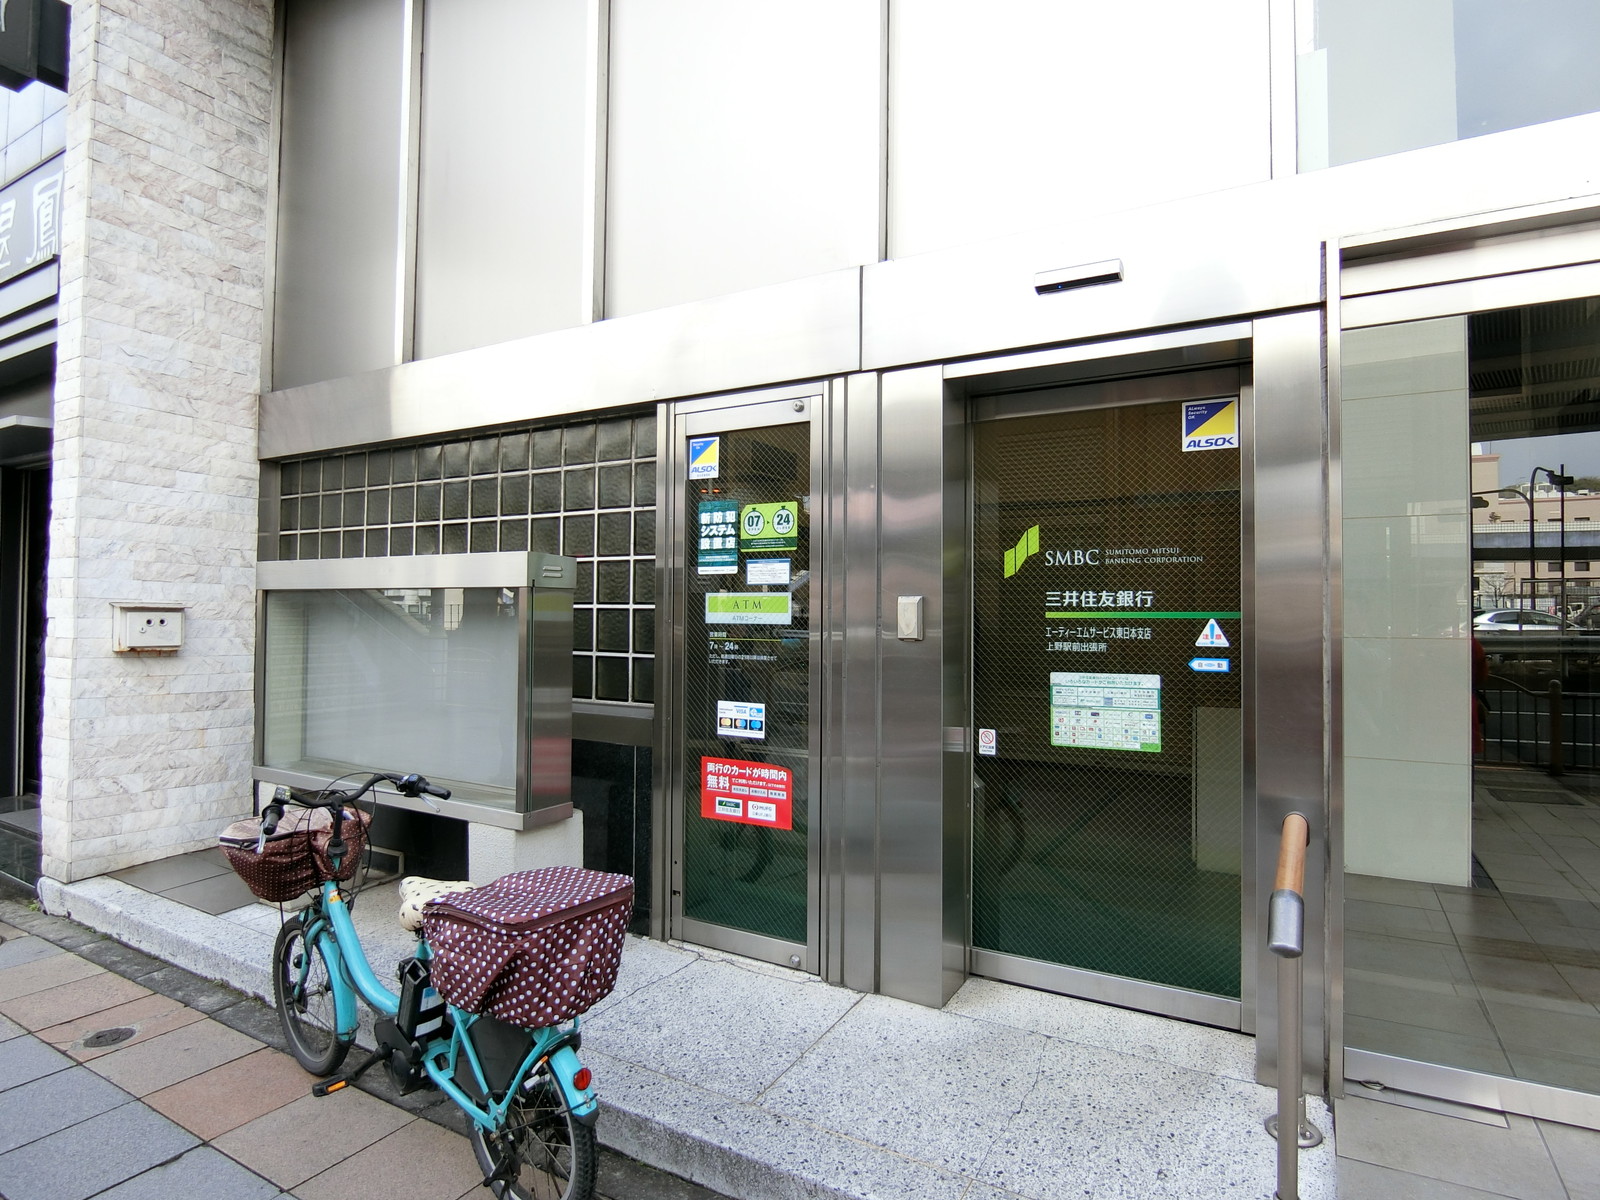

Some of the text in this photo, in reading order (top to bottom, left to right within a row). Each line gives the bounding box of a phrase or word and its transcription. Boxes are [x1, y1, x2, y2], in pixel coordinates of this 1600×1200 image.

[1186, 437, 1234, 449] ALSOK
[691, 465, 717, 474] ALSOK
[700, 510, 736, 525] 新防犯
[747, 514, 790, 527] 07 24
[700, 524, 736, 537] システム
[700, 537, 736, 550] 設置店
[1045, 549, 1100, 567] SMBC
[1105, 547, 1180, 556] SUMITOMO MITSUI
[1105, 555, 1204, 565] BANKING CORPORATION
[732, 600, 762, 610] ATM
[1045, 590, 1154, 608] 三井住友銀行
[1045, 626, 1151, 640] エーティーエムサービス東日本支店
[1046, 641, 1107, 652] 上野駅前出張所
[706, 762, 787, 781] 両行のカードが時間内
[706, 774, 730, 790] 無料
